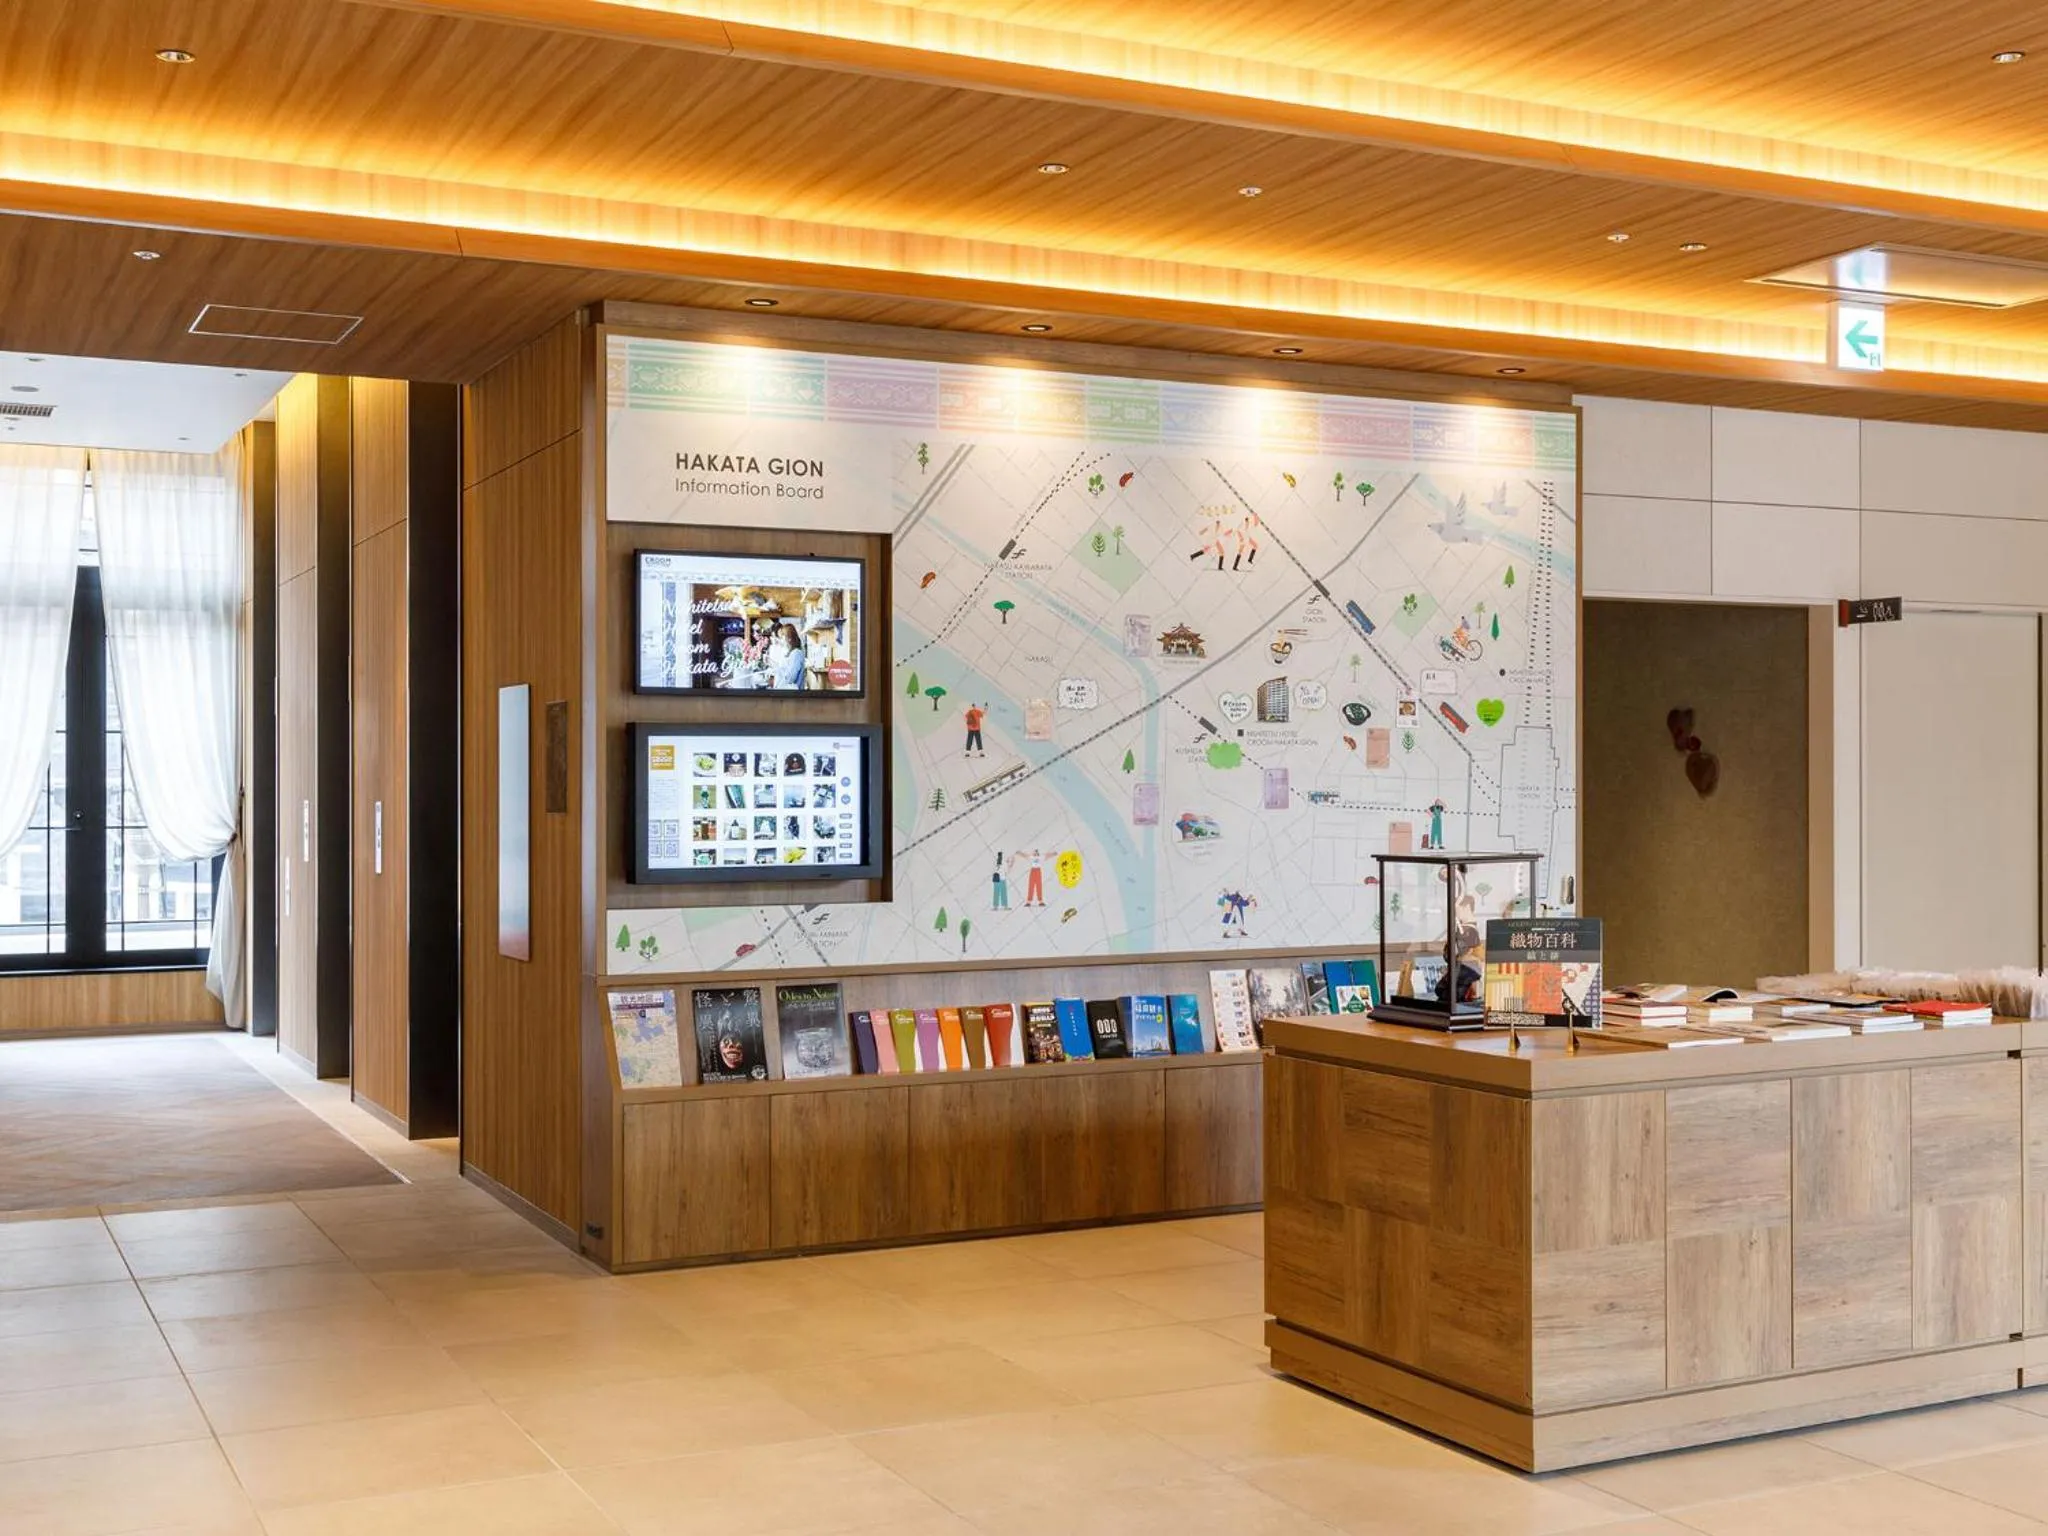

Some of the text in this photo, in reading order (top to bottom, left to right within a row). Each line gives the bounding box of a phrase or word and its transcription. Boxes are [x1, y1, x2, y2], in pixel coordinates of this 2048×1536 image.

[676, 452, 824, 477] HAKATA GION
[675, 478, 824, 499] Information Board
[1509, 932, 1577, 949] 織物百科
